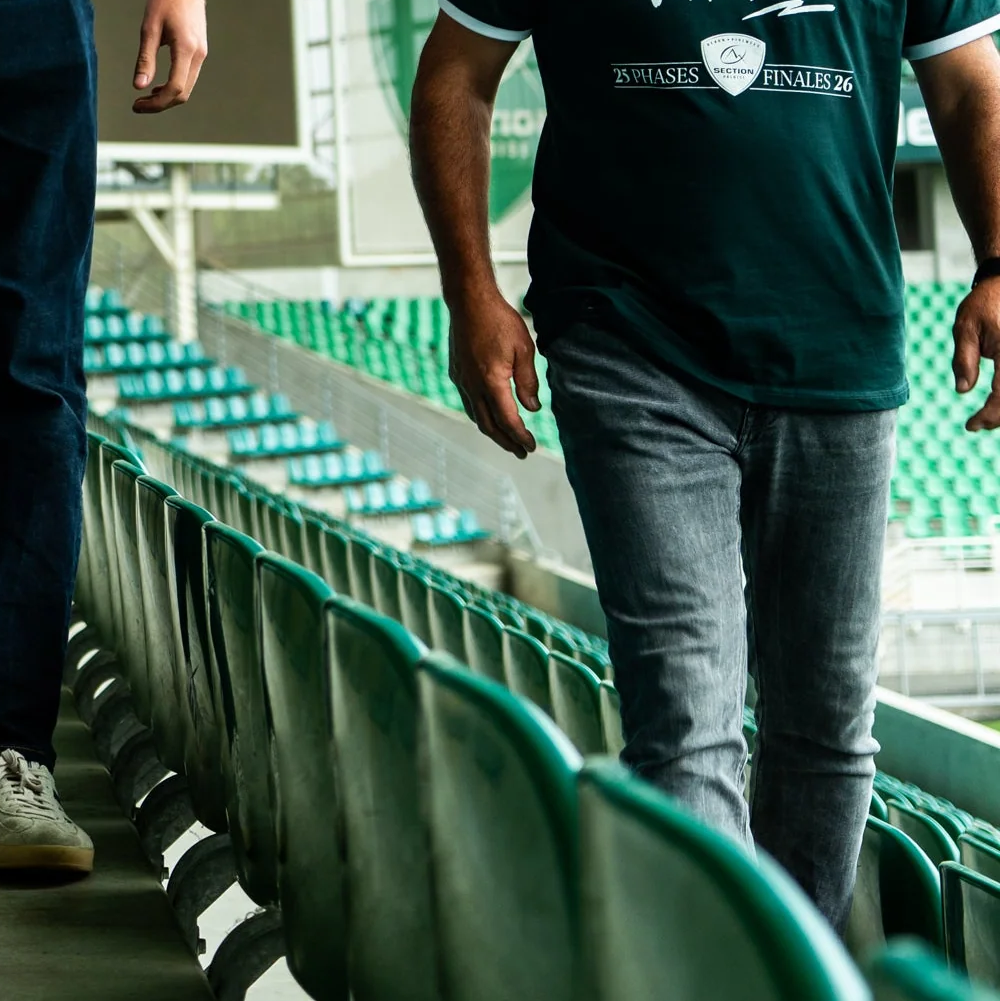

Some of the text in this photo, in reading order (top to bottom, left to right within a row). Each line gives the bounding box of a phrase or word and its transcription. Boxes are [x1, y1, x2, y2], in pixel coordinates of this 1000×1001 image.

[613, 67, 700, 84] 25 PHASES
[713, 67, 754, 75] SECTION
[763, 68, 853, 93] FINALES 26
